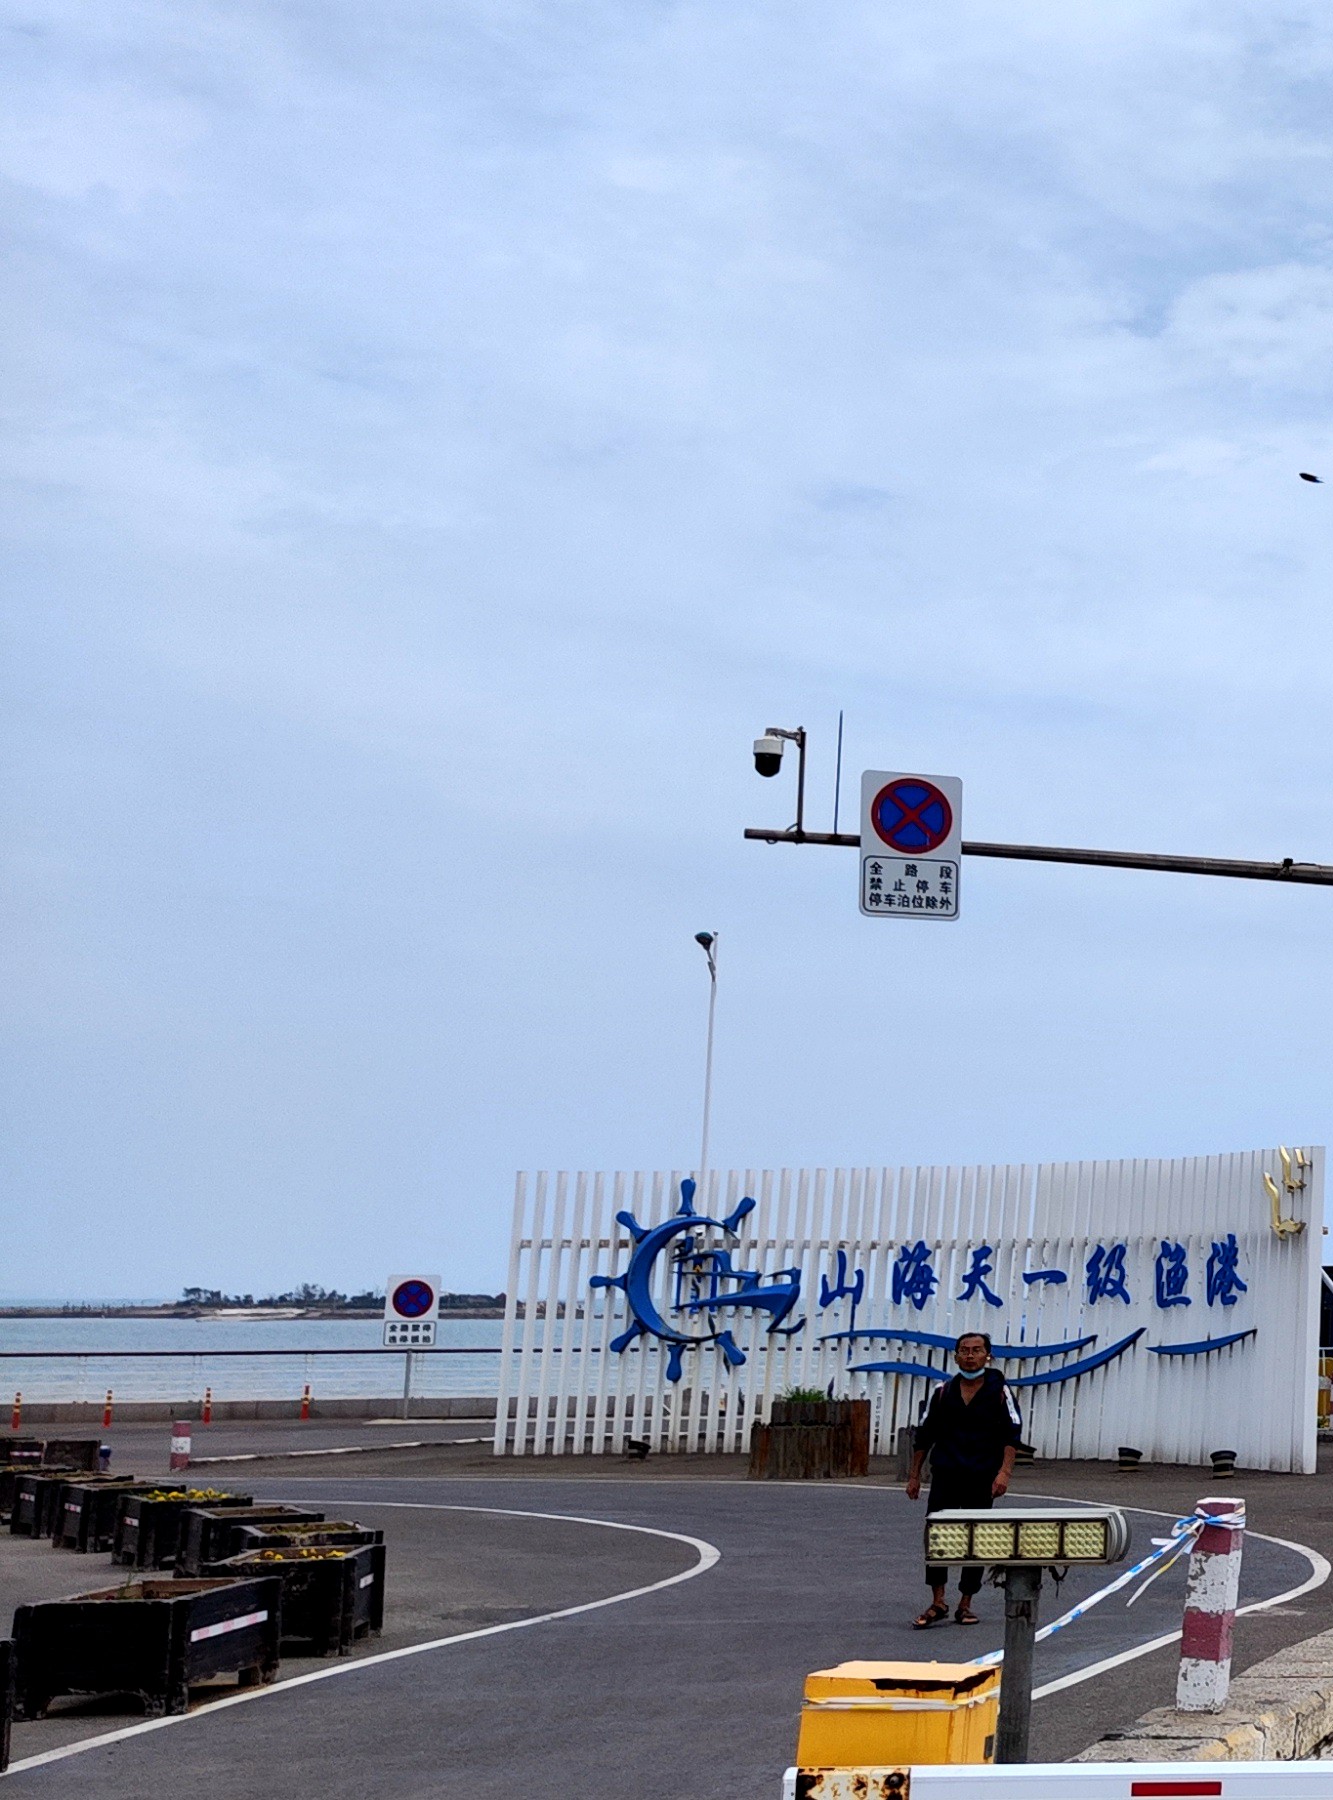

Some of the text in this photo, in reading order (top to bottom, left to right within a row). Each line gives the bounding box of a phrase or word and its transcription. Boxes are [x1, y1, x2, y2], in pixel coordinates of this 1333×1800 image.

[869, 861, 953, 879] 全路段
[869, 877, 953, 895] 禁止停车
[868, 892, 953, 911] 停车泊位除外
[819, 1233, 1247, 1311] 山海天一级渔港
